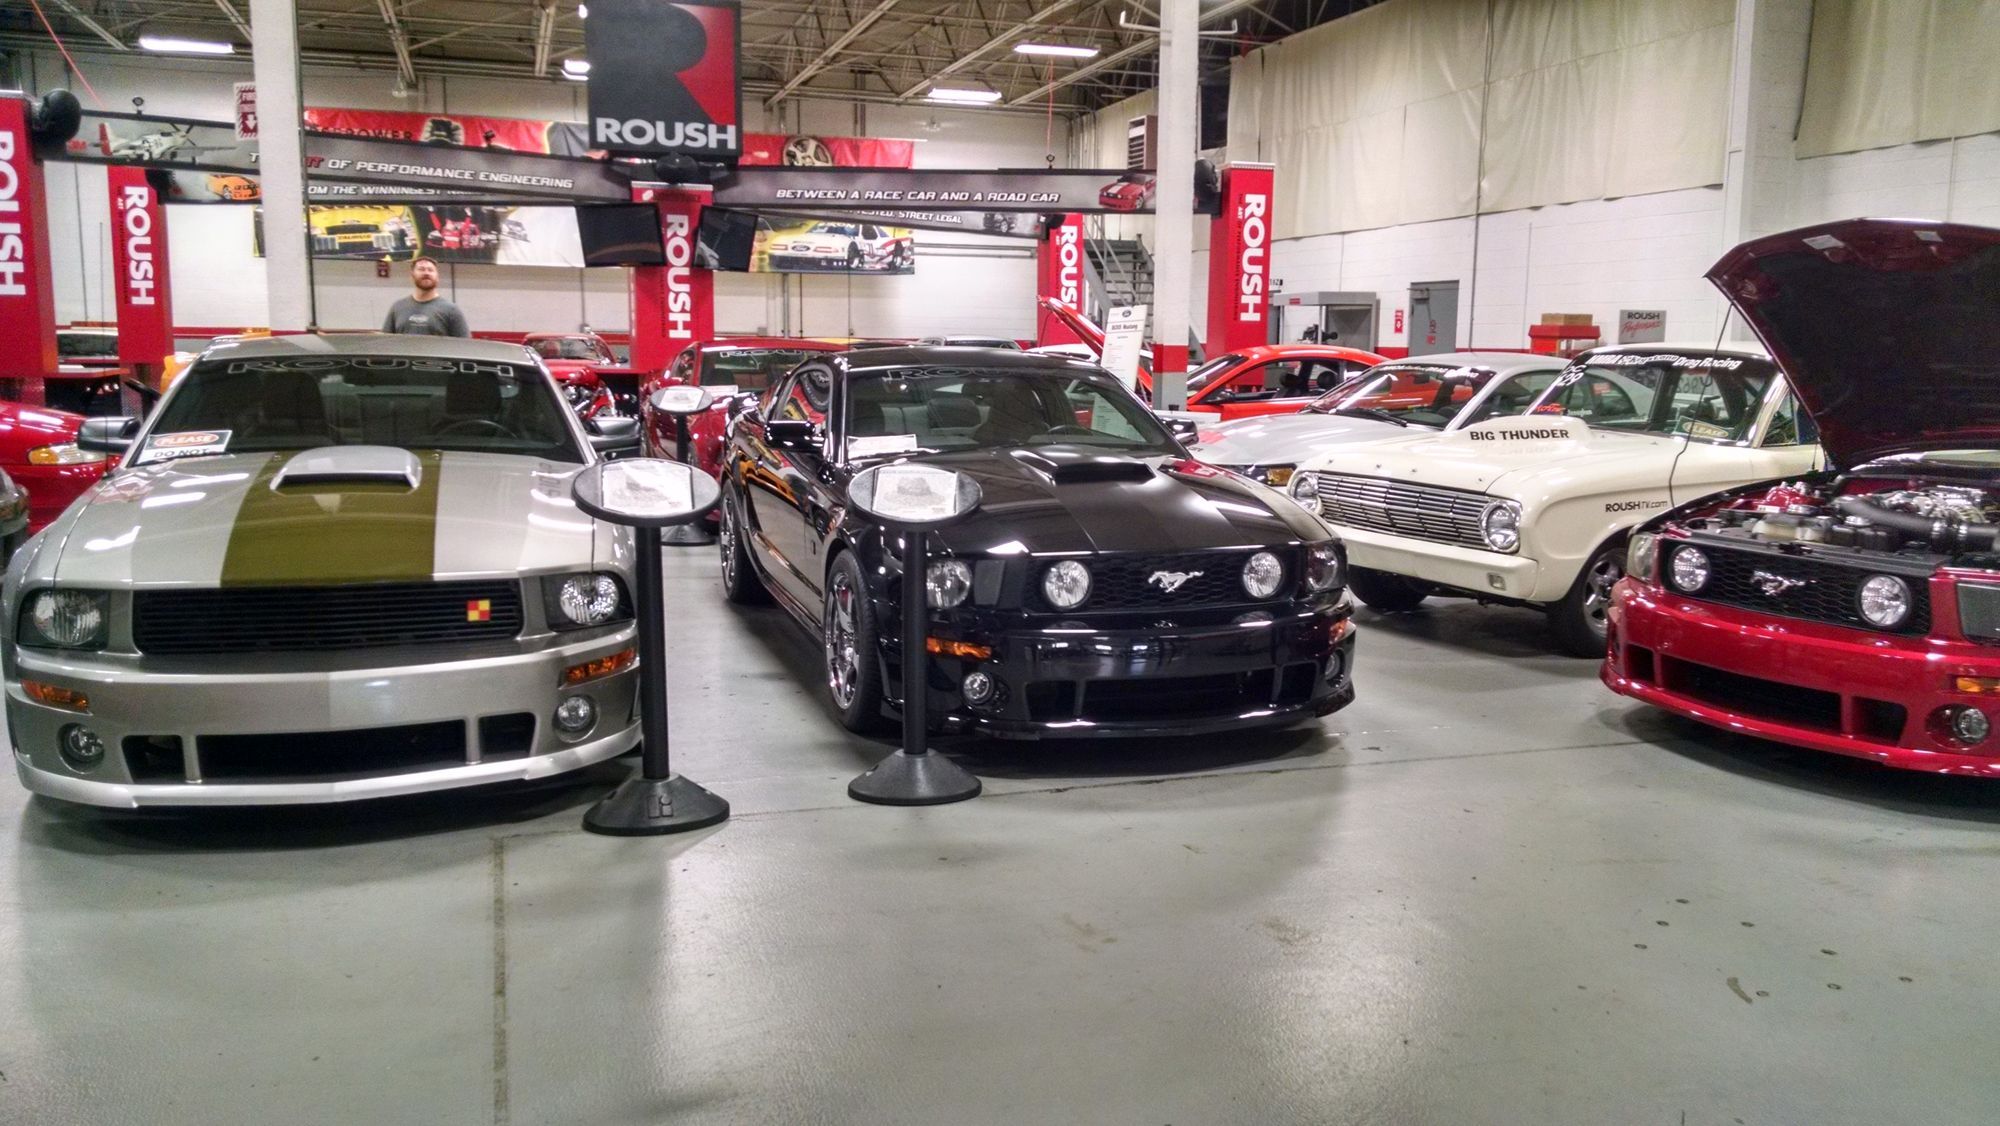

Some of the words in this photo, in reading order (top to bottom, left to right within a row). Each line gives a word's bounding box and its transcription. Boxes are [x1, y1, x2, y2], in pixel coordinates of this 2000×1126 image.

[596, 117, 736, 149] ROUSH
[328, 159, 351, 169] OF
[356, 161, 475, 180] PERFORMANCE
[479, 171, 574, 189] ENGINEERING
[333, 186, 357, 195] THE
[776, 189, 846, 199] BETWEEN
[850, 191, 860, 200] A
[864, 191, 902, 200] RACE
[907, 191, 937, 201] CAR
[940, 191, 969, 201] AND
[973, 192, 984, 201] A
[987, 192, 1027, 202] ROAD
[1030, 193, 1060, 202] CAR
[899, 211, 934, 220] STREET
[936, 215, 962, 223] LEGAL
[124, 186, 155, 305] ROUSH
[1240, 194, 1266, 321] ROUSH
[666, 213, 691, 339] ROUSH
[1627, 311, 1661, 320] ROUSH
[228, 358, 515, 377] ROUSH
[1672, 356, 1701, 368] Drag
[1699, 357, 1743, 370] Racing
[161, 434, 212, 446] PLEASE
[1470, 431, 1495, 441] BIG
[1499, 429, 1570, 440] THUNDER
[154, 450, 175, 458] DO
[178, 448, 210, 456] NOT
[1605, 501, 1668, 513] ROUSHTV.com
